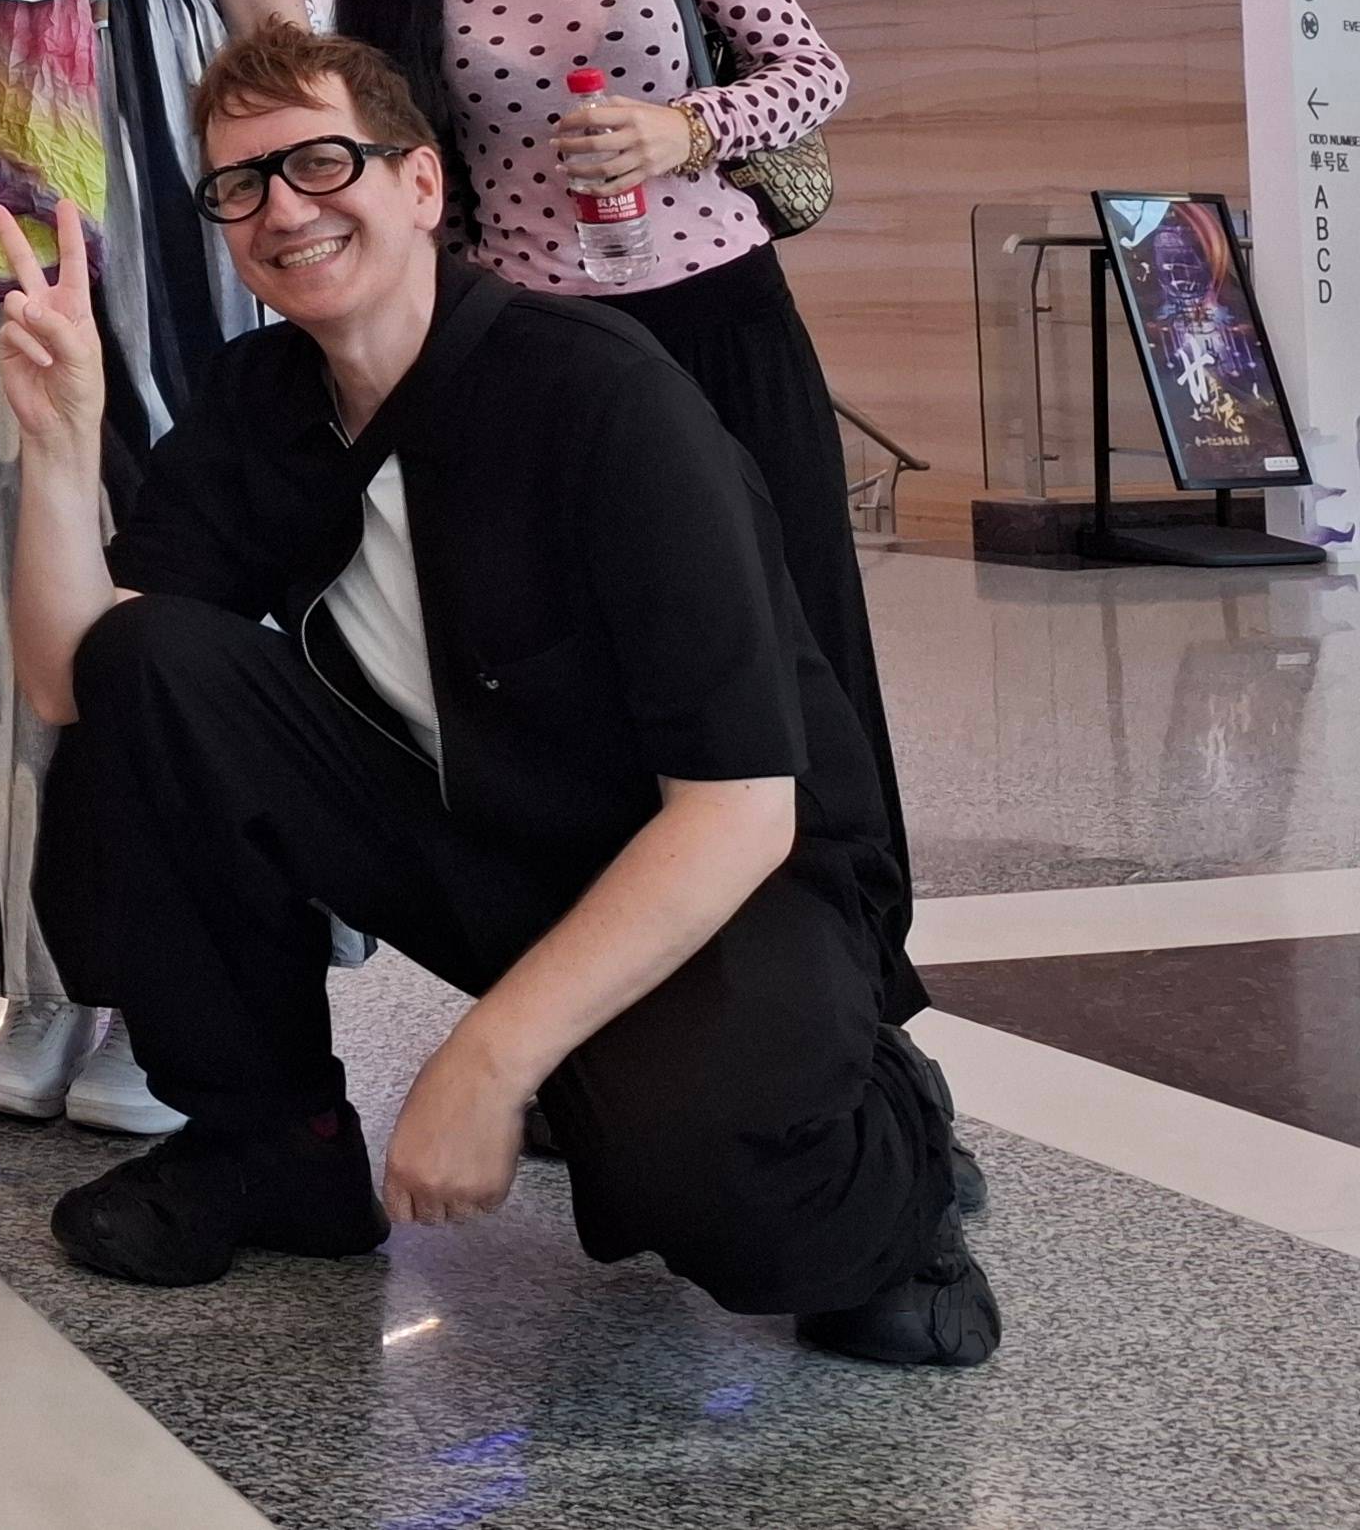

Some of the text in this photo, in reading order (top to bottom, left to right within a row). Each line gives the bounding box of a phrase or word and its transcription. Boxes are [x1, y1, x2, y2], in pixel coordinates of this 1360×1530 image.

[1309, 133, 1328, 145] ODD
[1309, 150, 1350, 172] 单号区
[1314, 184, 1329, 209] A
[1316, 216, 1329, 241] B
[1317, 247, 1331, 272] C
[1318, 279, 1332, 304] D
